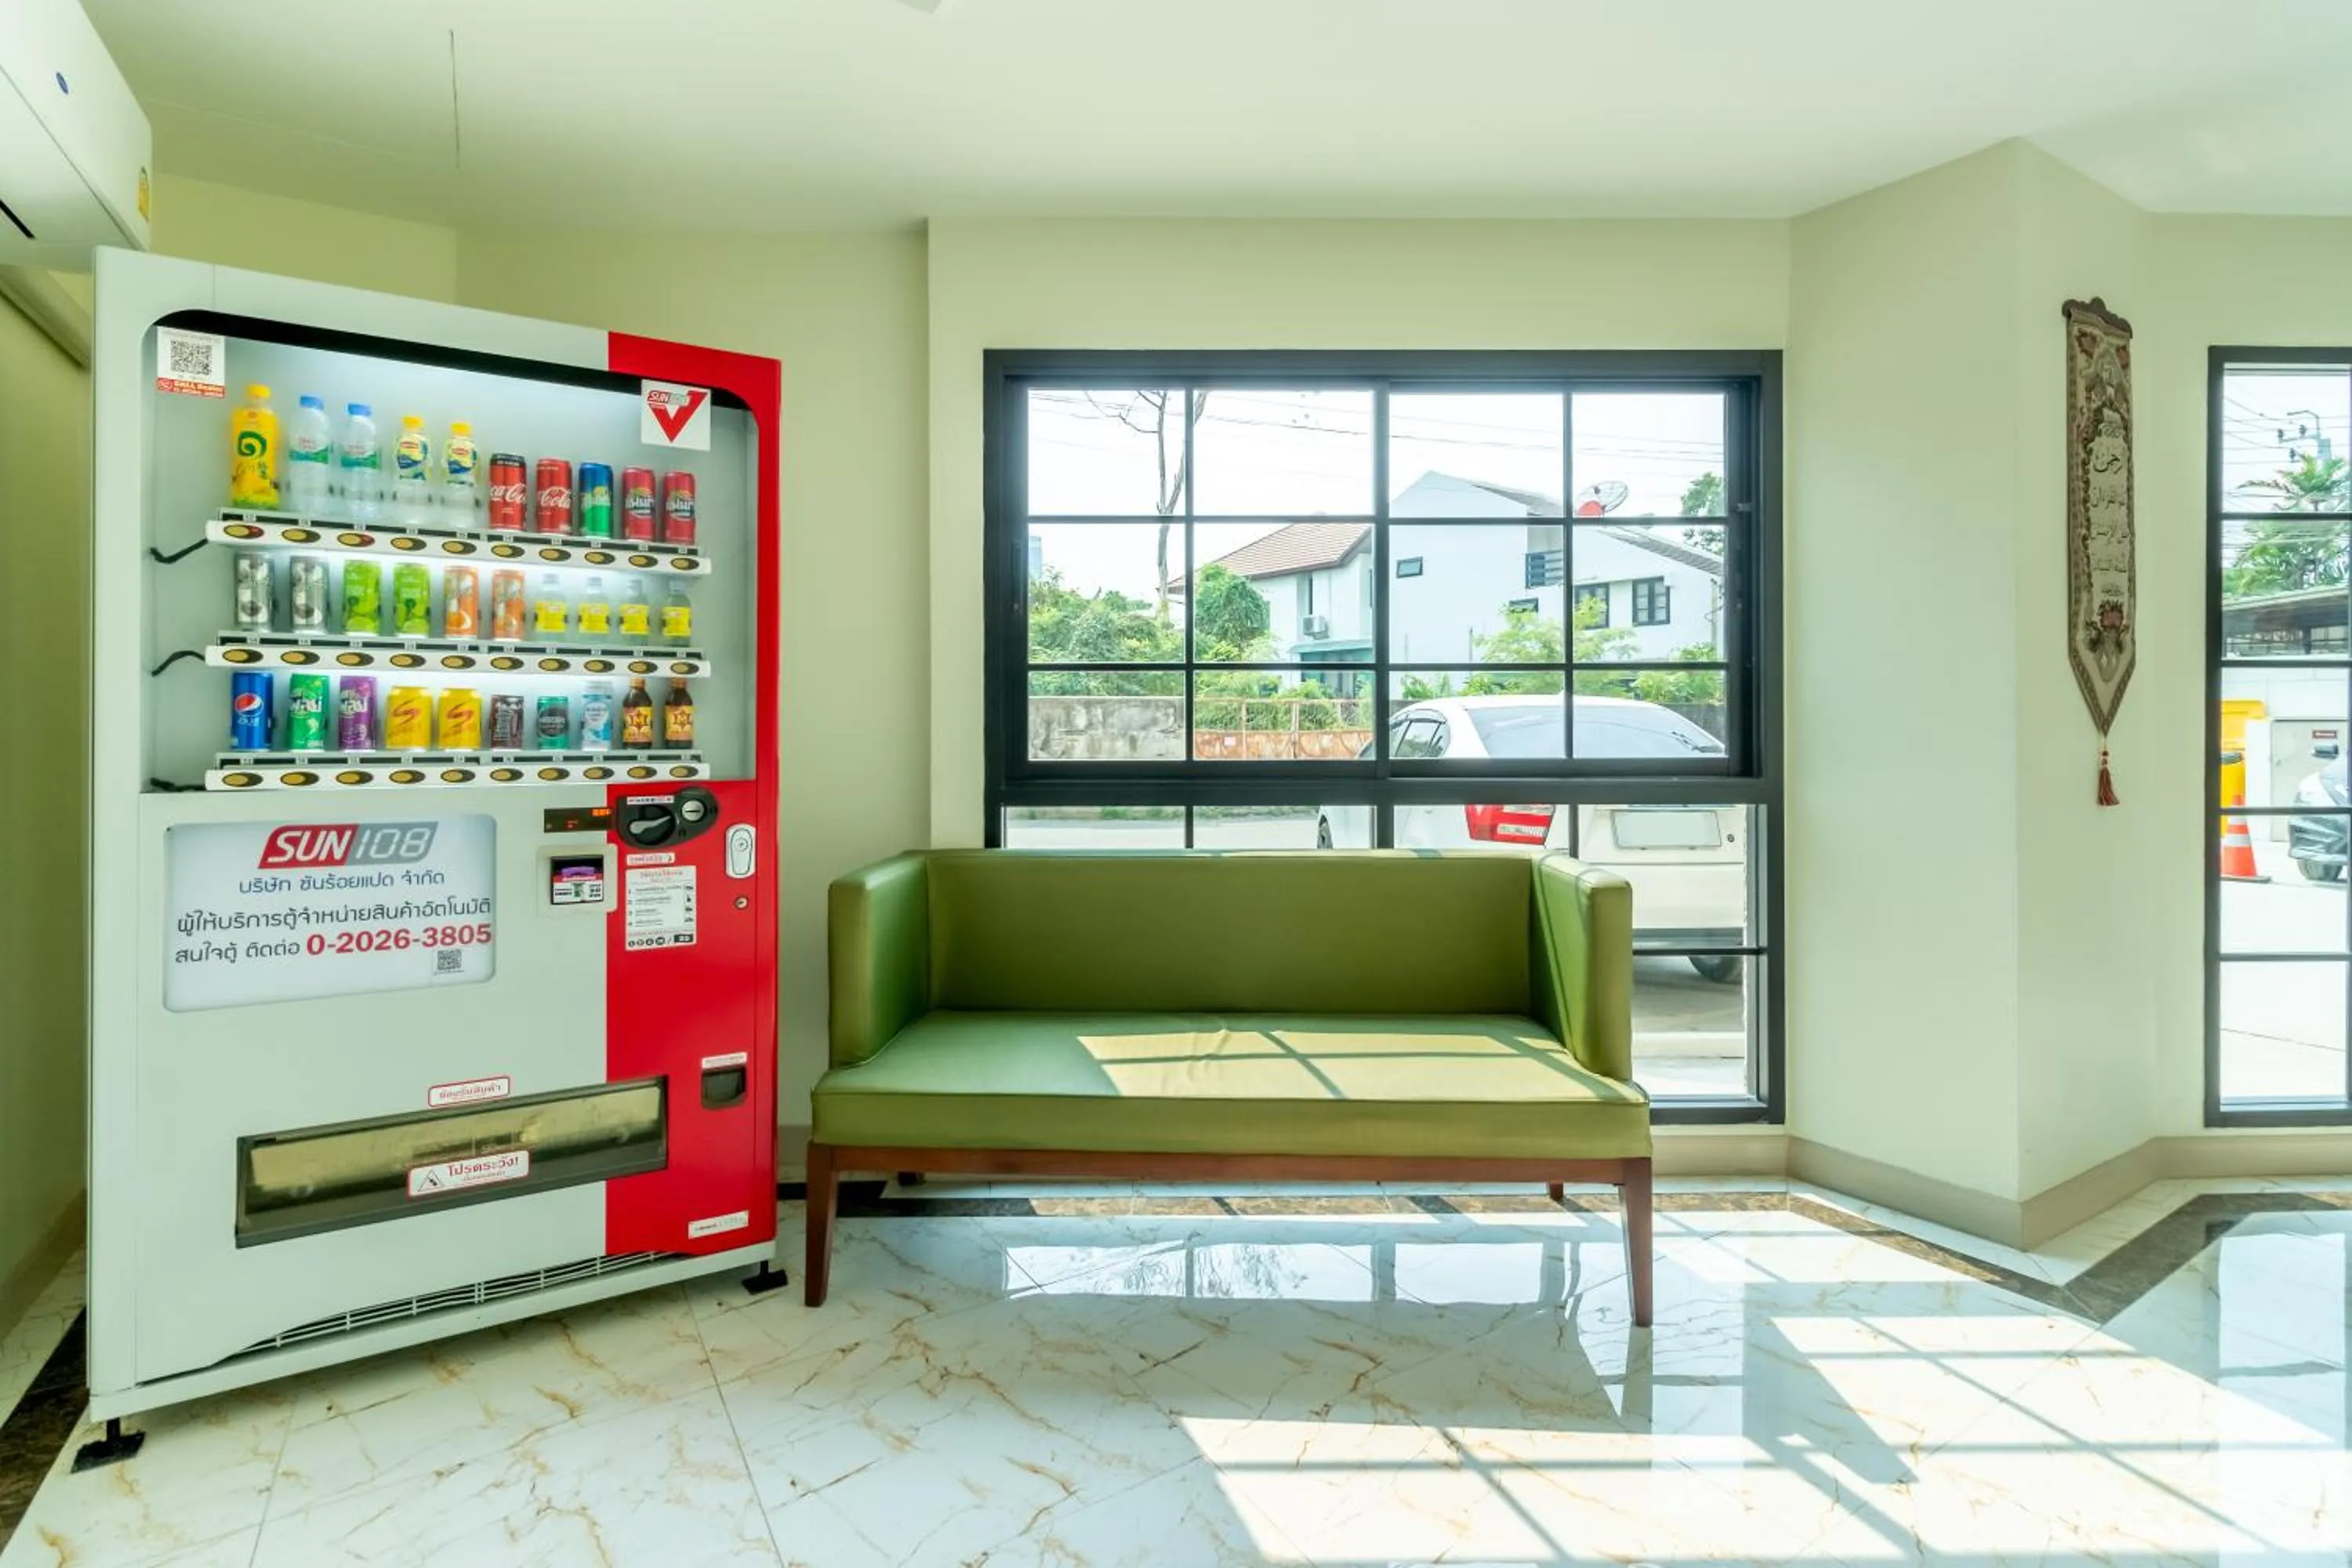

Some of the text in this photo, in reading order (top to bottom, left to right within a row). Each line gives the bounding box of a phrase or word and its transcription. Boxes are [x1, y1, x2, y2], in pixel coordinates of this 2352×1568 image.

[239, 869, 445, 894] บริษัท ซันร้อยแปด จำกัด
[175, 923, 492, 964] สนใจตู้ ติดต่อ 0-2026-3805
